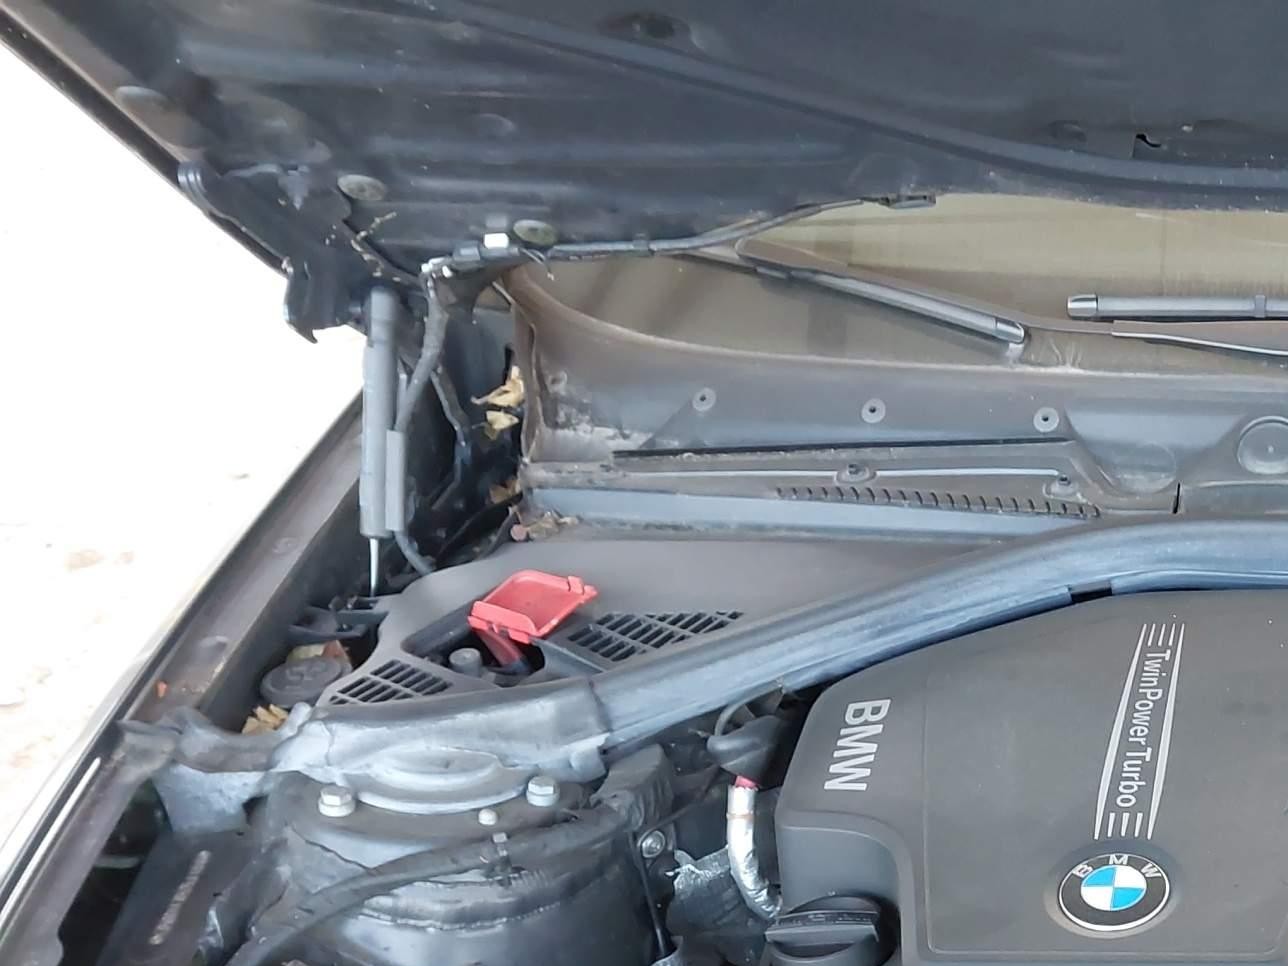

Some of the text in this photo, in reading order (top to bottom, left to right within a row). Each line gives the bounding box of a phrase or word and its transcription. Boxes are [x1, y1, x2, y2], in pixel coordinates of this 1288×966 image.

[823, 699, 891, 791] BMW
[1116, 649, 1171, 807] TwinPower Turbo
[1072, 854, 1162, 878] BMW
